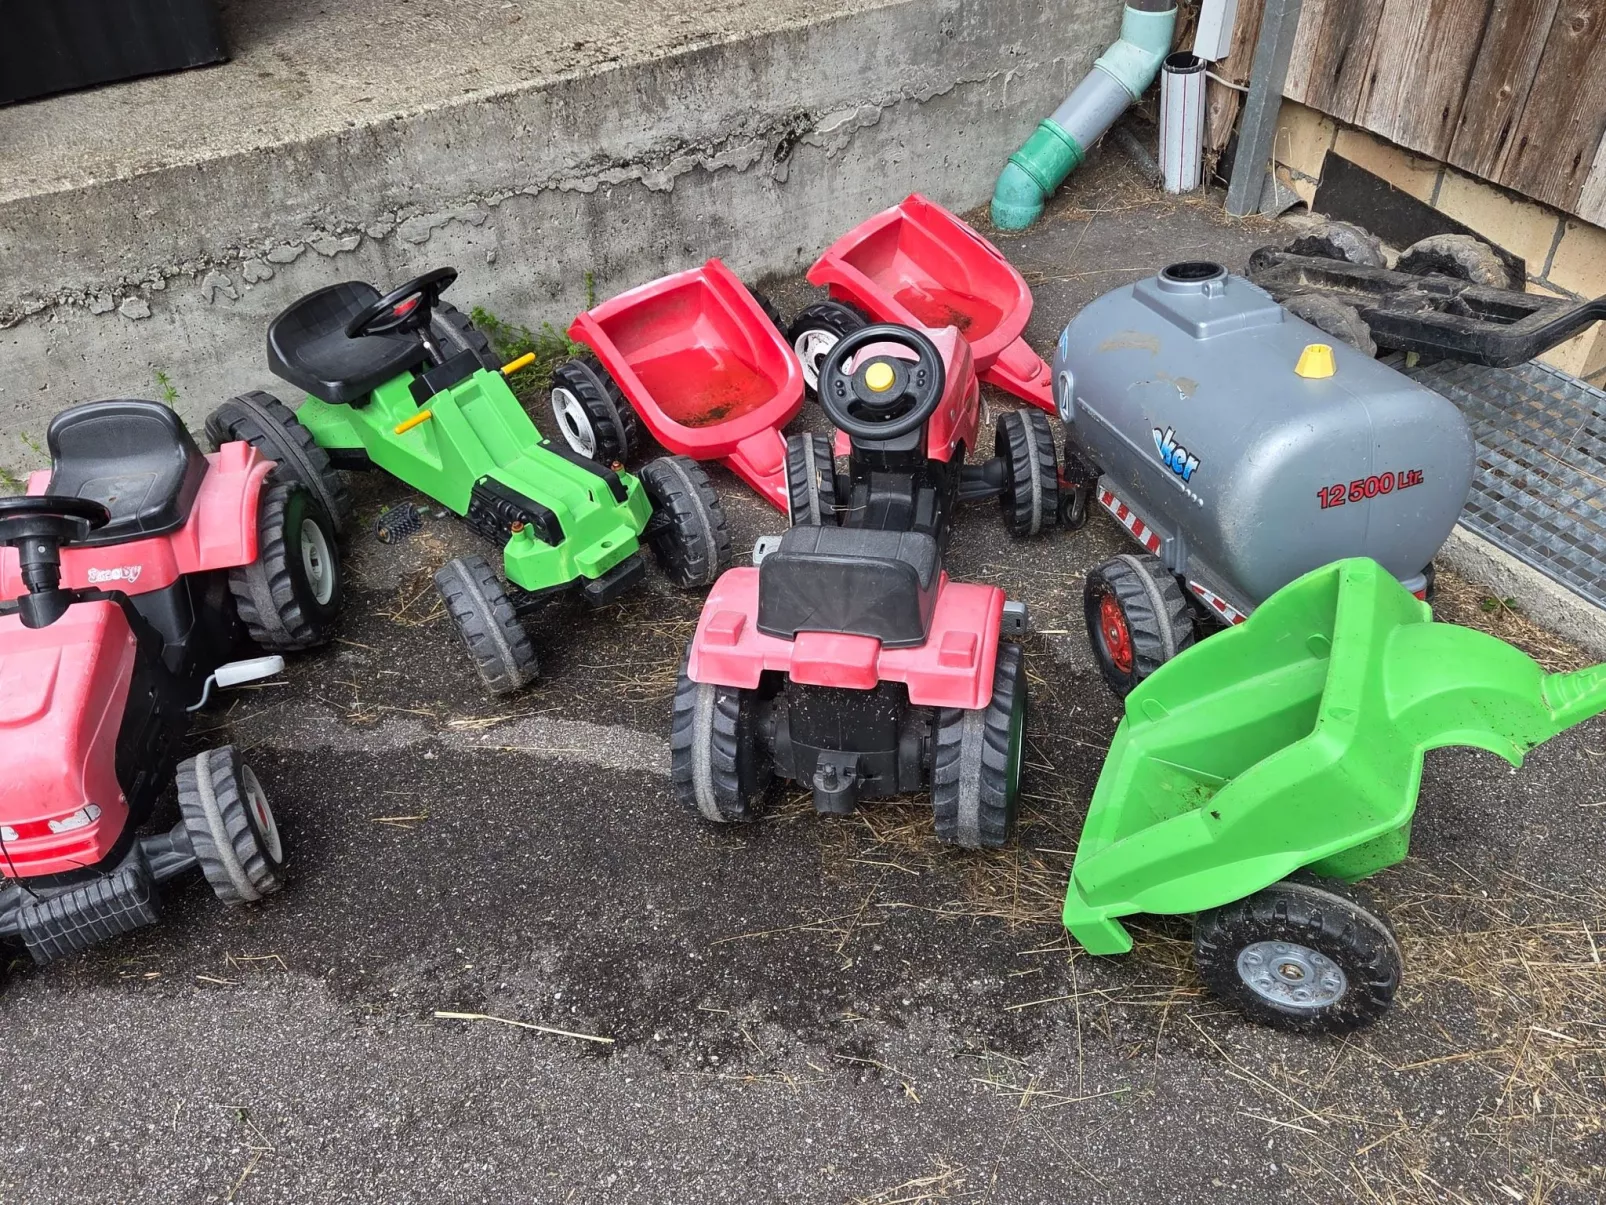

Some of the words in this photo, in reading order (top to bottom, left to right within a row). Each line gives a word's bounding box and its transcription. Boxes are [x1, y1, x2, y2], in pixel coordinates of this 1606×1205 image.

[1317, 484, 1346, 509] 12
[1348, 472, 1395, 502] 500
[1397, 470, 1424, 490] Ltr.
